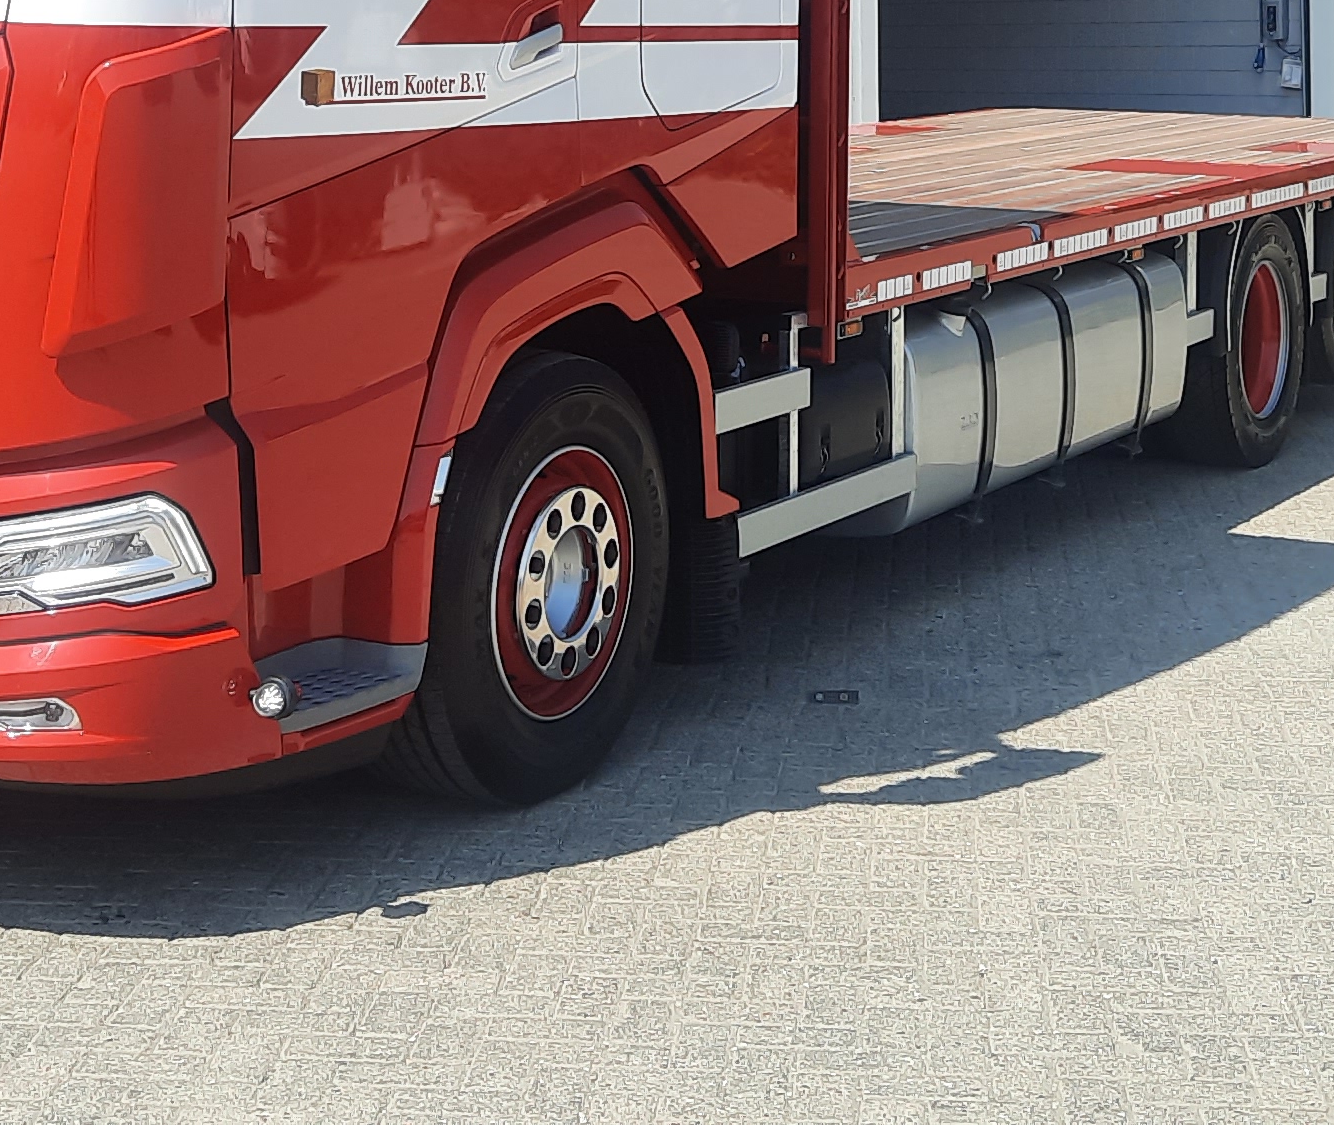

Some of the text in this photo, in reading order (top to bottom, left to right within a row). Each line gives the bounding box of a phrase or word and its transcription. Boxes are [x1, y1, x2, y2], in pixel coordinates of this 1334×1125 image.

[341, 72, 486, 97] Willem Kooter B.V.
